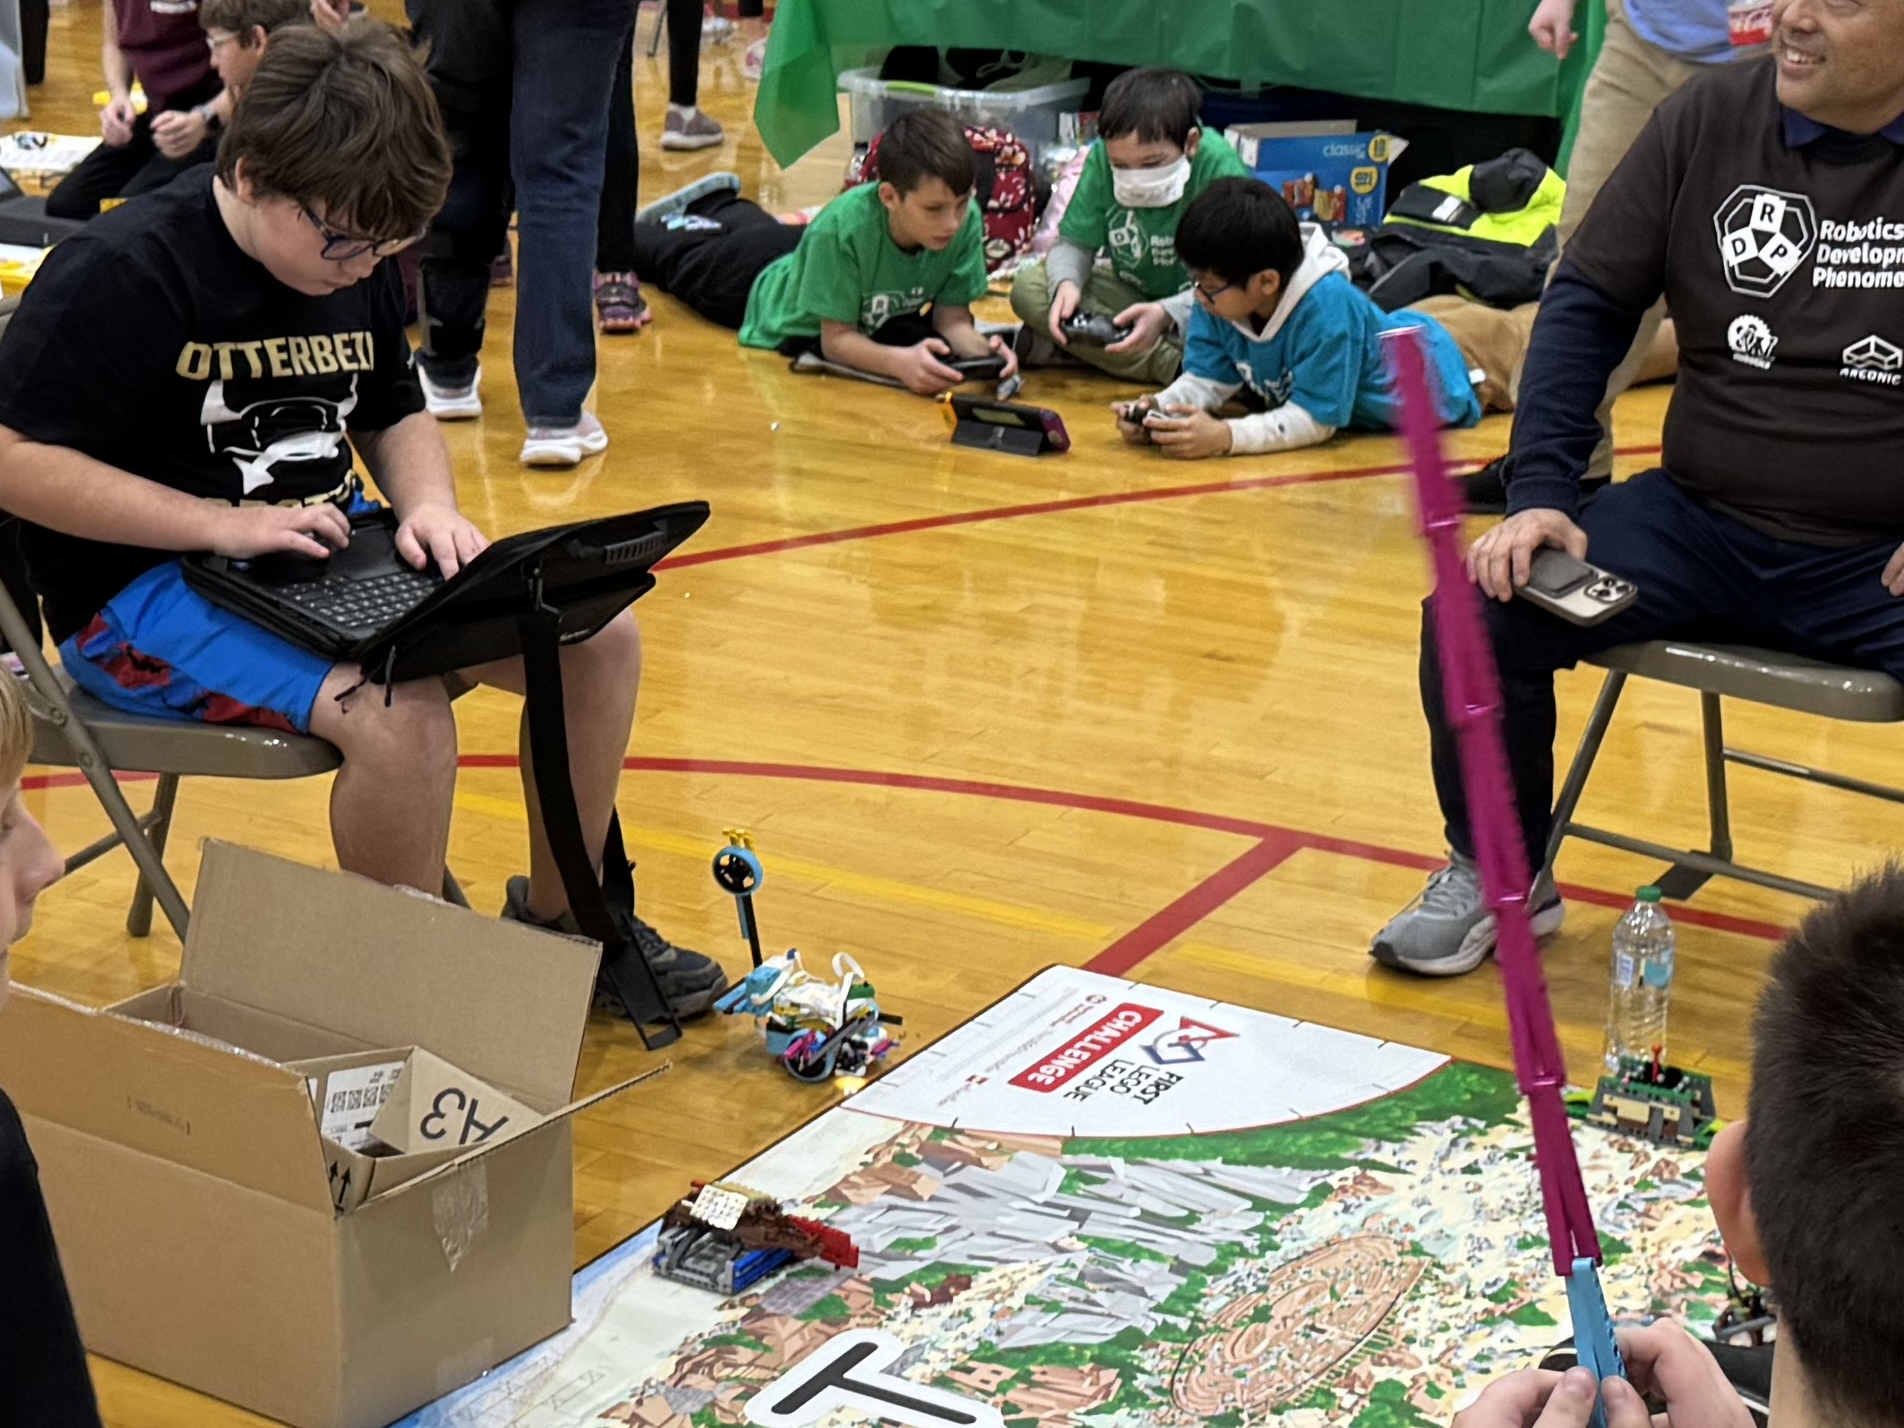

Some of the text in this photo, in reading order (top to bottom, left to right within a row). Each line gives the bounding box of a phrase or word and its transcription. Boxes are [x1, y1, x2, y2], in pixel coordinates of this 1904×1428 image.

[175, 331, 375, 381] OTTERBEI
[1027, 1010, 1143, 1086] CHALLENGE
[1063, 1058, 1136, 1102] LEAGUE
[1109, 1064, 1161, 1095] LEGO
[1133, 1071, 1184, 1105] FIRST
